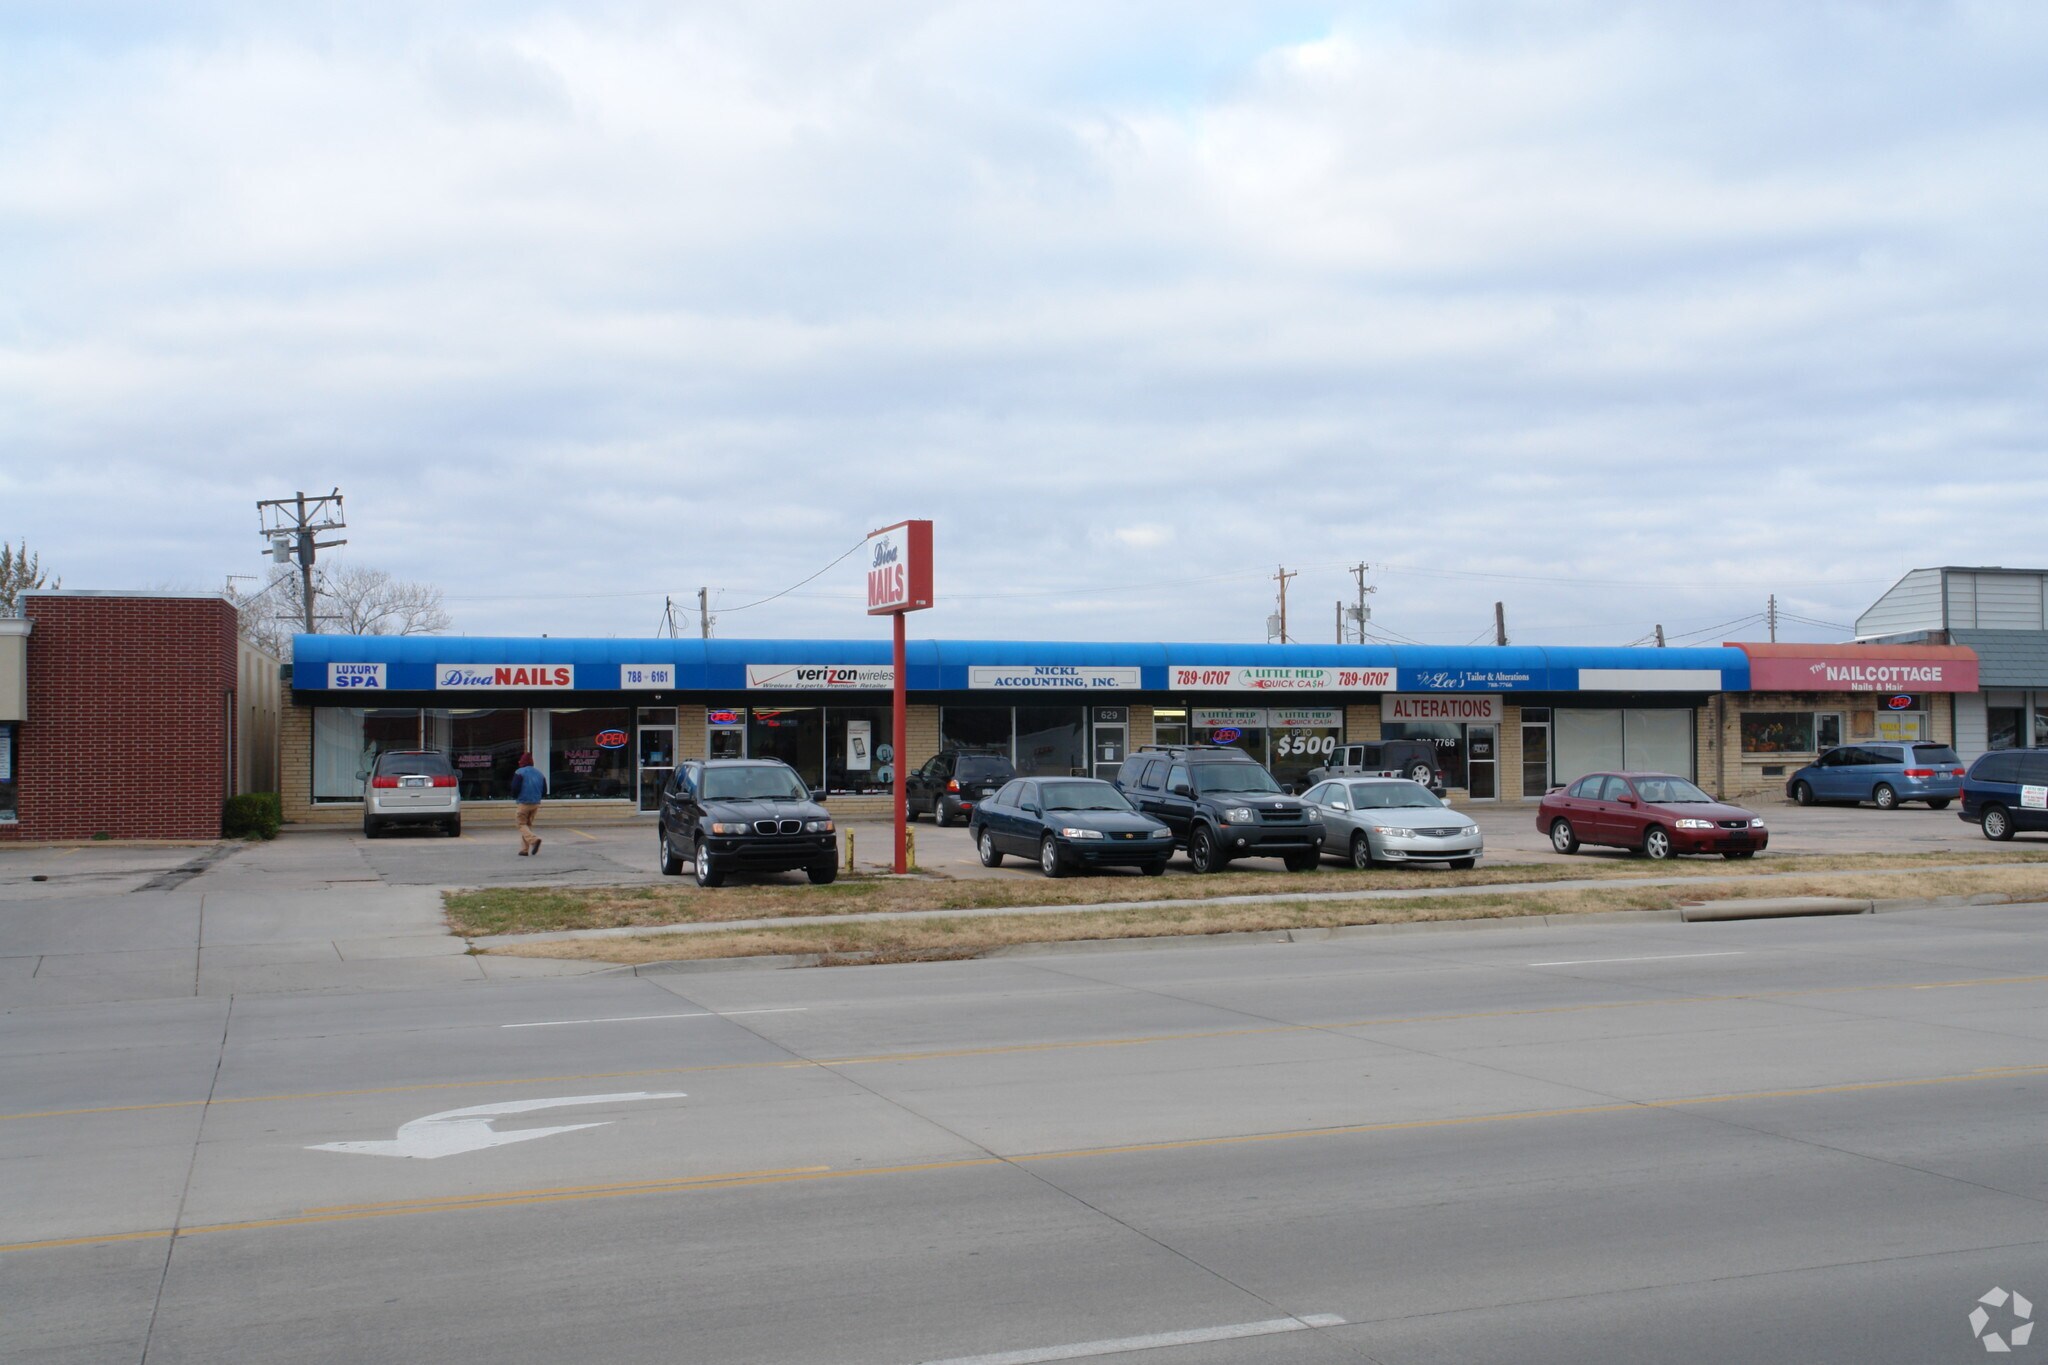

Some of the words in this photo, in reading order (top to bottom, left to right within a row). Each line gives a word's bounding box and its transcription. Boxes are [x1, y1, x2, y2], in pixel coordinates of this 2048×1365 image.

[873, 541, 898, 568] Diva
[868, 563, 904, 607] NAILS
[336, 665, 378, 675] LUXURY
[1034, 667, 1079, 675] NICKL
[1244, 669, 1252, 678] A
[1255, 669, 1292, 678] LITTLE
[1296, 669, 1324, 678] HELP
[1809, 662, 1826, 674] The
[441, 670, 493, 686] Diva
[495, 668, 570, 686] NAILS
[797, 666, 857, 684] verizon
[858, 669, 894, 681] wireles
[1466, 672, 1486, 681] Tailor
[1487, 672, 1494, 681] &
[1495, 672, 1529, 681] Alterations
[336, 676, 379, 687] SPA
[994, 677, 1088, 688] ACCOUNTING,
[1092, 677, 1119, 687] INC.
[1263, 680, 1294, 688] QUICK
[1851, 683, 1873, 691] Nails
[1876, 683, 1883, 691] &
[1885, 683, 1904, 691] Hair
[1393, 699, 1492, 717] ALTERATIONS
[1100, 711, 1118, 720] 629
[595, 733, 628, 745] OPEN
[1213, 730, 1238, 740] OPEN
[1278, 734, 1335, 757] $500
